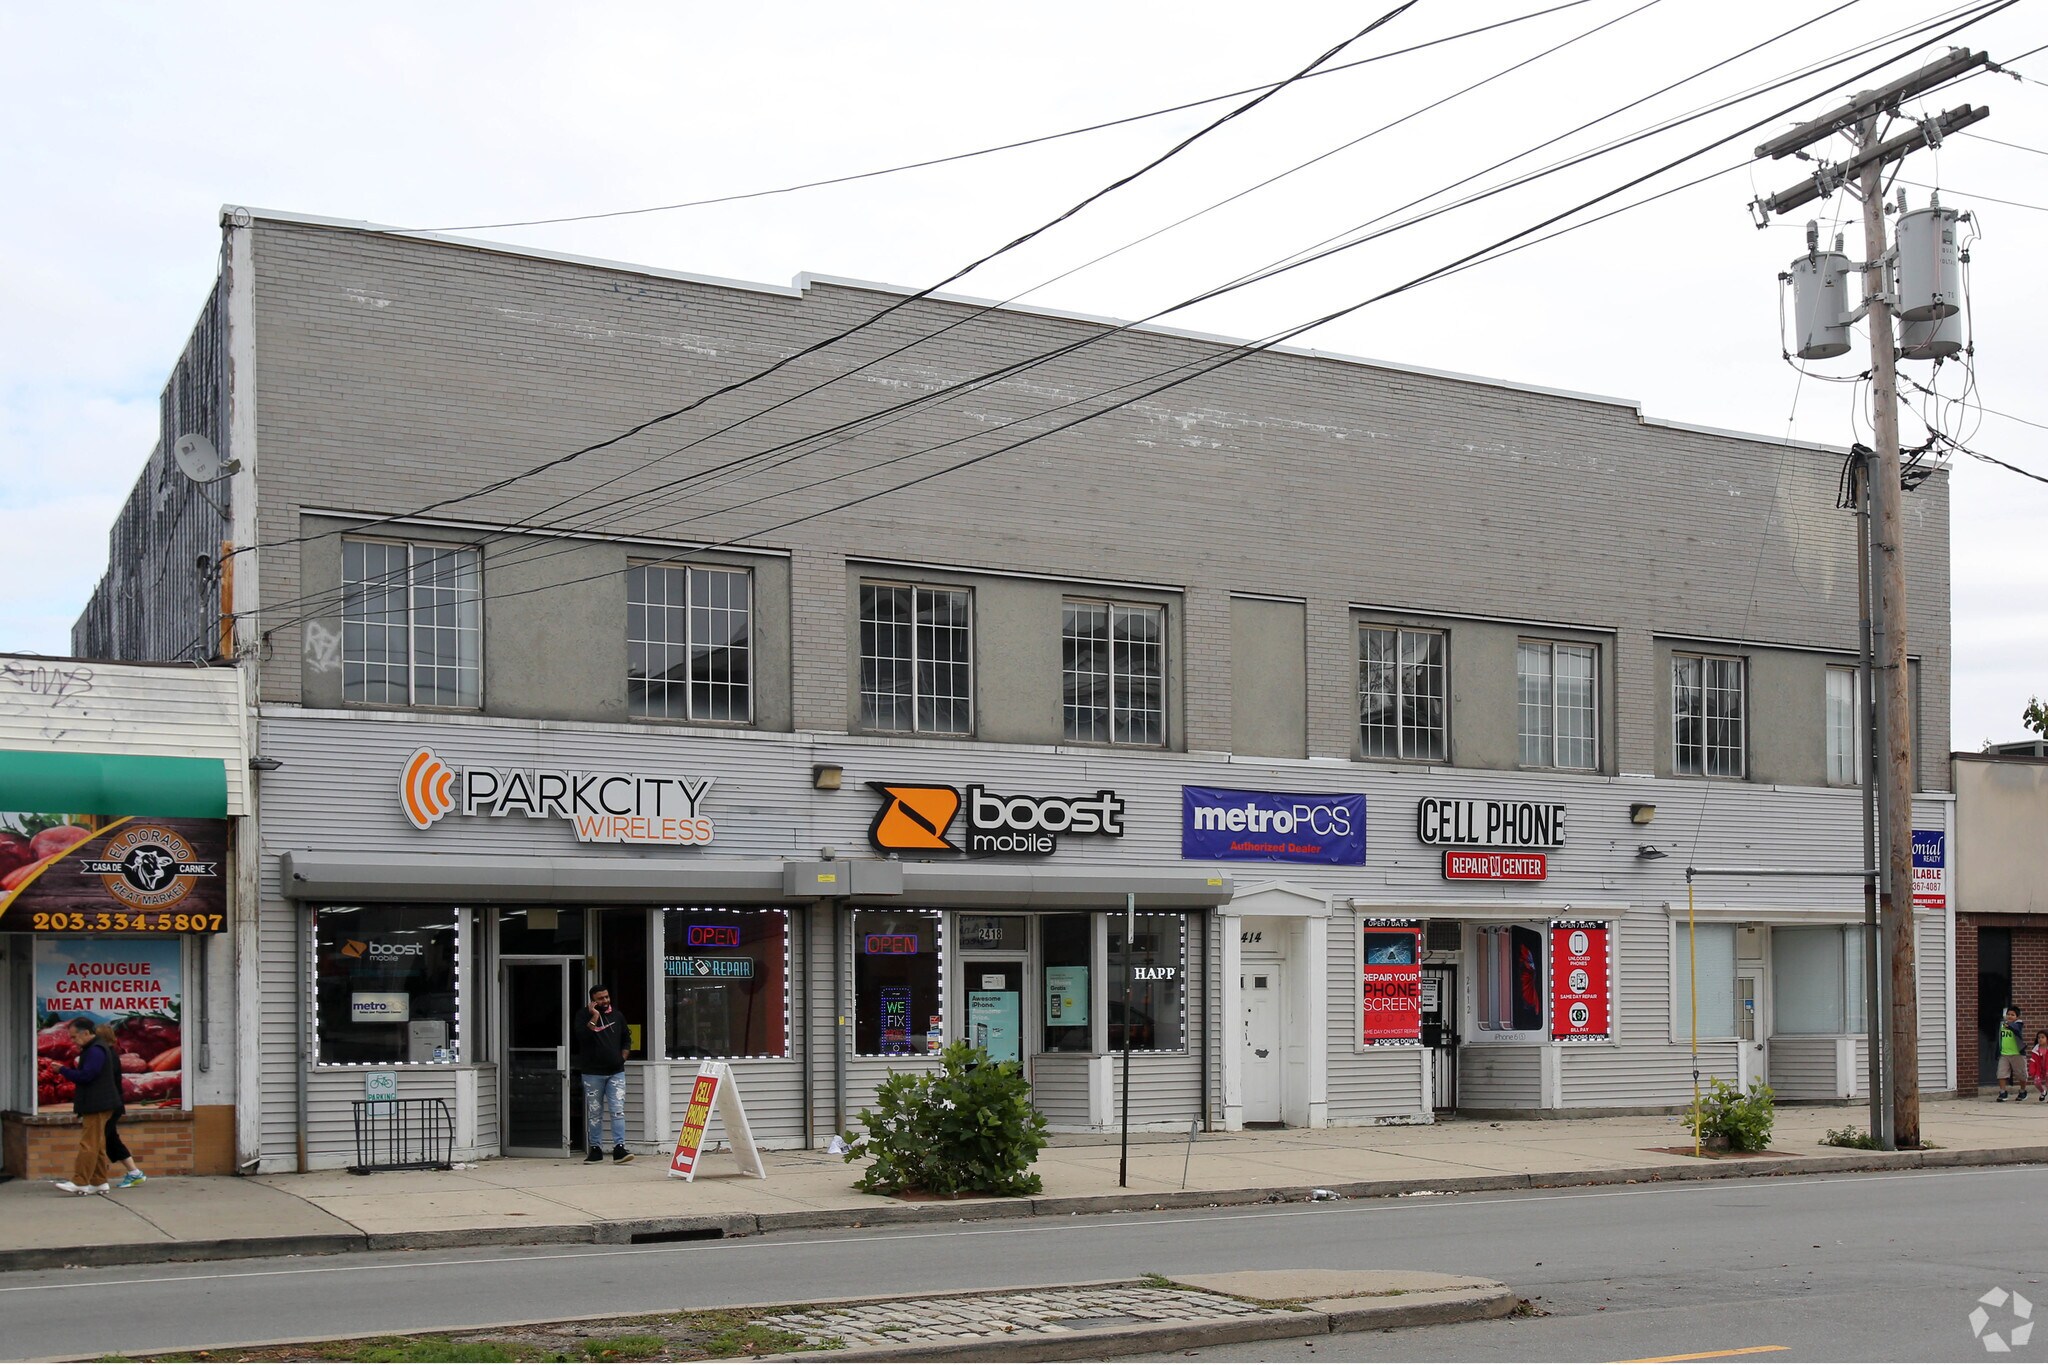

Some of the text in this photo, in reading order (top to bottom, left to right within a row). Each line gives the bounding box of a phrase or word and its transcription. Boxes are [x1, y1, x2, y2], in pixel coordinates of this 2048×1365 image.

[467, 771, 709, 819] PARKCITY
[972, 788, 1122, 834] boost
[1194, 802, 1351, 836] metroPCS
[577, 815, 711, 842] WIRELESS
[1422, 797, 1565, 846] CELL PHONE
[108, 829, 190, 861] EL DORADO
[973, 834, 1053, 852] mobile
[1230, 841, 1321, 854] Authorized Dealer
[1912, 834, 1944, 856] onial
[1452, 857, 1541, 875] REPAIR CENTER
[1923, 855, 1941, 863] REALTY
[92, 863, 206, 874] CASA DE CARNE
[111, 880, 187, 905] MEAT MARKET
[33, 912, 223, 932] 203.334.5807
[691, 927, 737, 944] OPEN
[980, 928, 1002, 939] 2418
[370, 941, 423, 955] boost
[868, 936, 914, 953] OPEN
[66, 962, 151, 978] AÇOUGUE
[664, 960, 750, 975] PHONE REPAIR
[1134, 967, 1176, 980] HAPP
[56, 980, 162, 993] CARNICERIA
[1364, 983, 1417, 997] PHONE
[47, 997, 170, 1010] MEAT MARKET
[886, 1002, 905, 1013] WE
[1364, 998, 1417, 1011] SCREEN
[887, 1015, 905, 1027] FIX
[695, 1081, 712, 1103] CELL
[685, 1103, 709, 1127] PHONE
[678, 1126, 702, 1149] REPAIR
